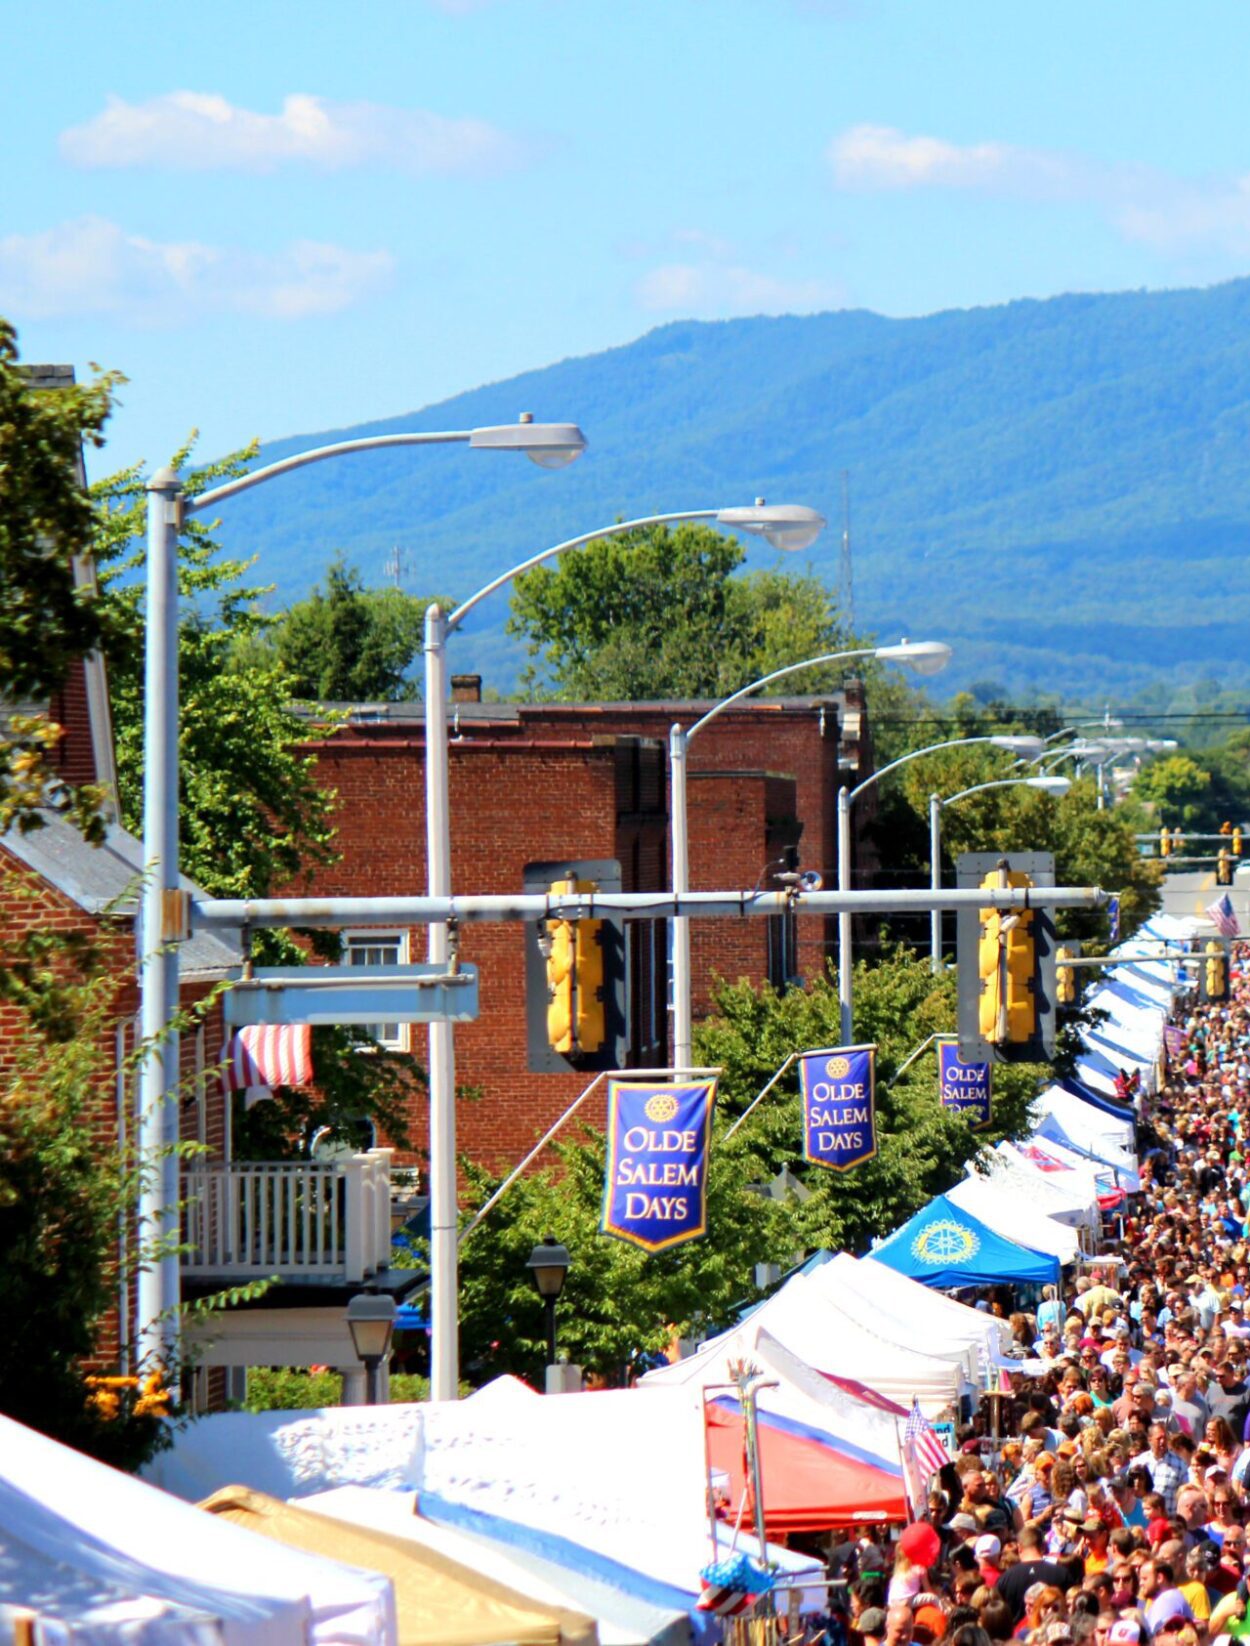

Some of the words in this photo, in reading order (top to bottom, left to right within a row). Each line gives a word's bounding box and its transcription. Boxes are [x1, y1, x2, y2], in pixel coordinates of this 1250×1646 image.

[946, 1066, 985, 1082] OLDE
[812, 1082, 866, 1102] OLDE
[943, 1084, 987, 1100] SALEM
[810, 1106, 869, 1128] SALEM
[623, 1126, 697, 1153] OLDE
[817, 1131, 864, 1152] DAYS
[617, 1157, 699, 1187] SALEM
[624, 1192, 689, 1220] DAYS
